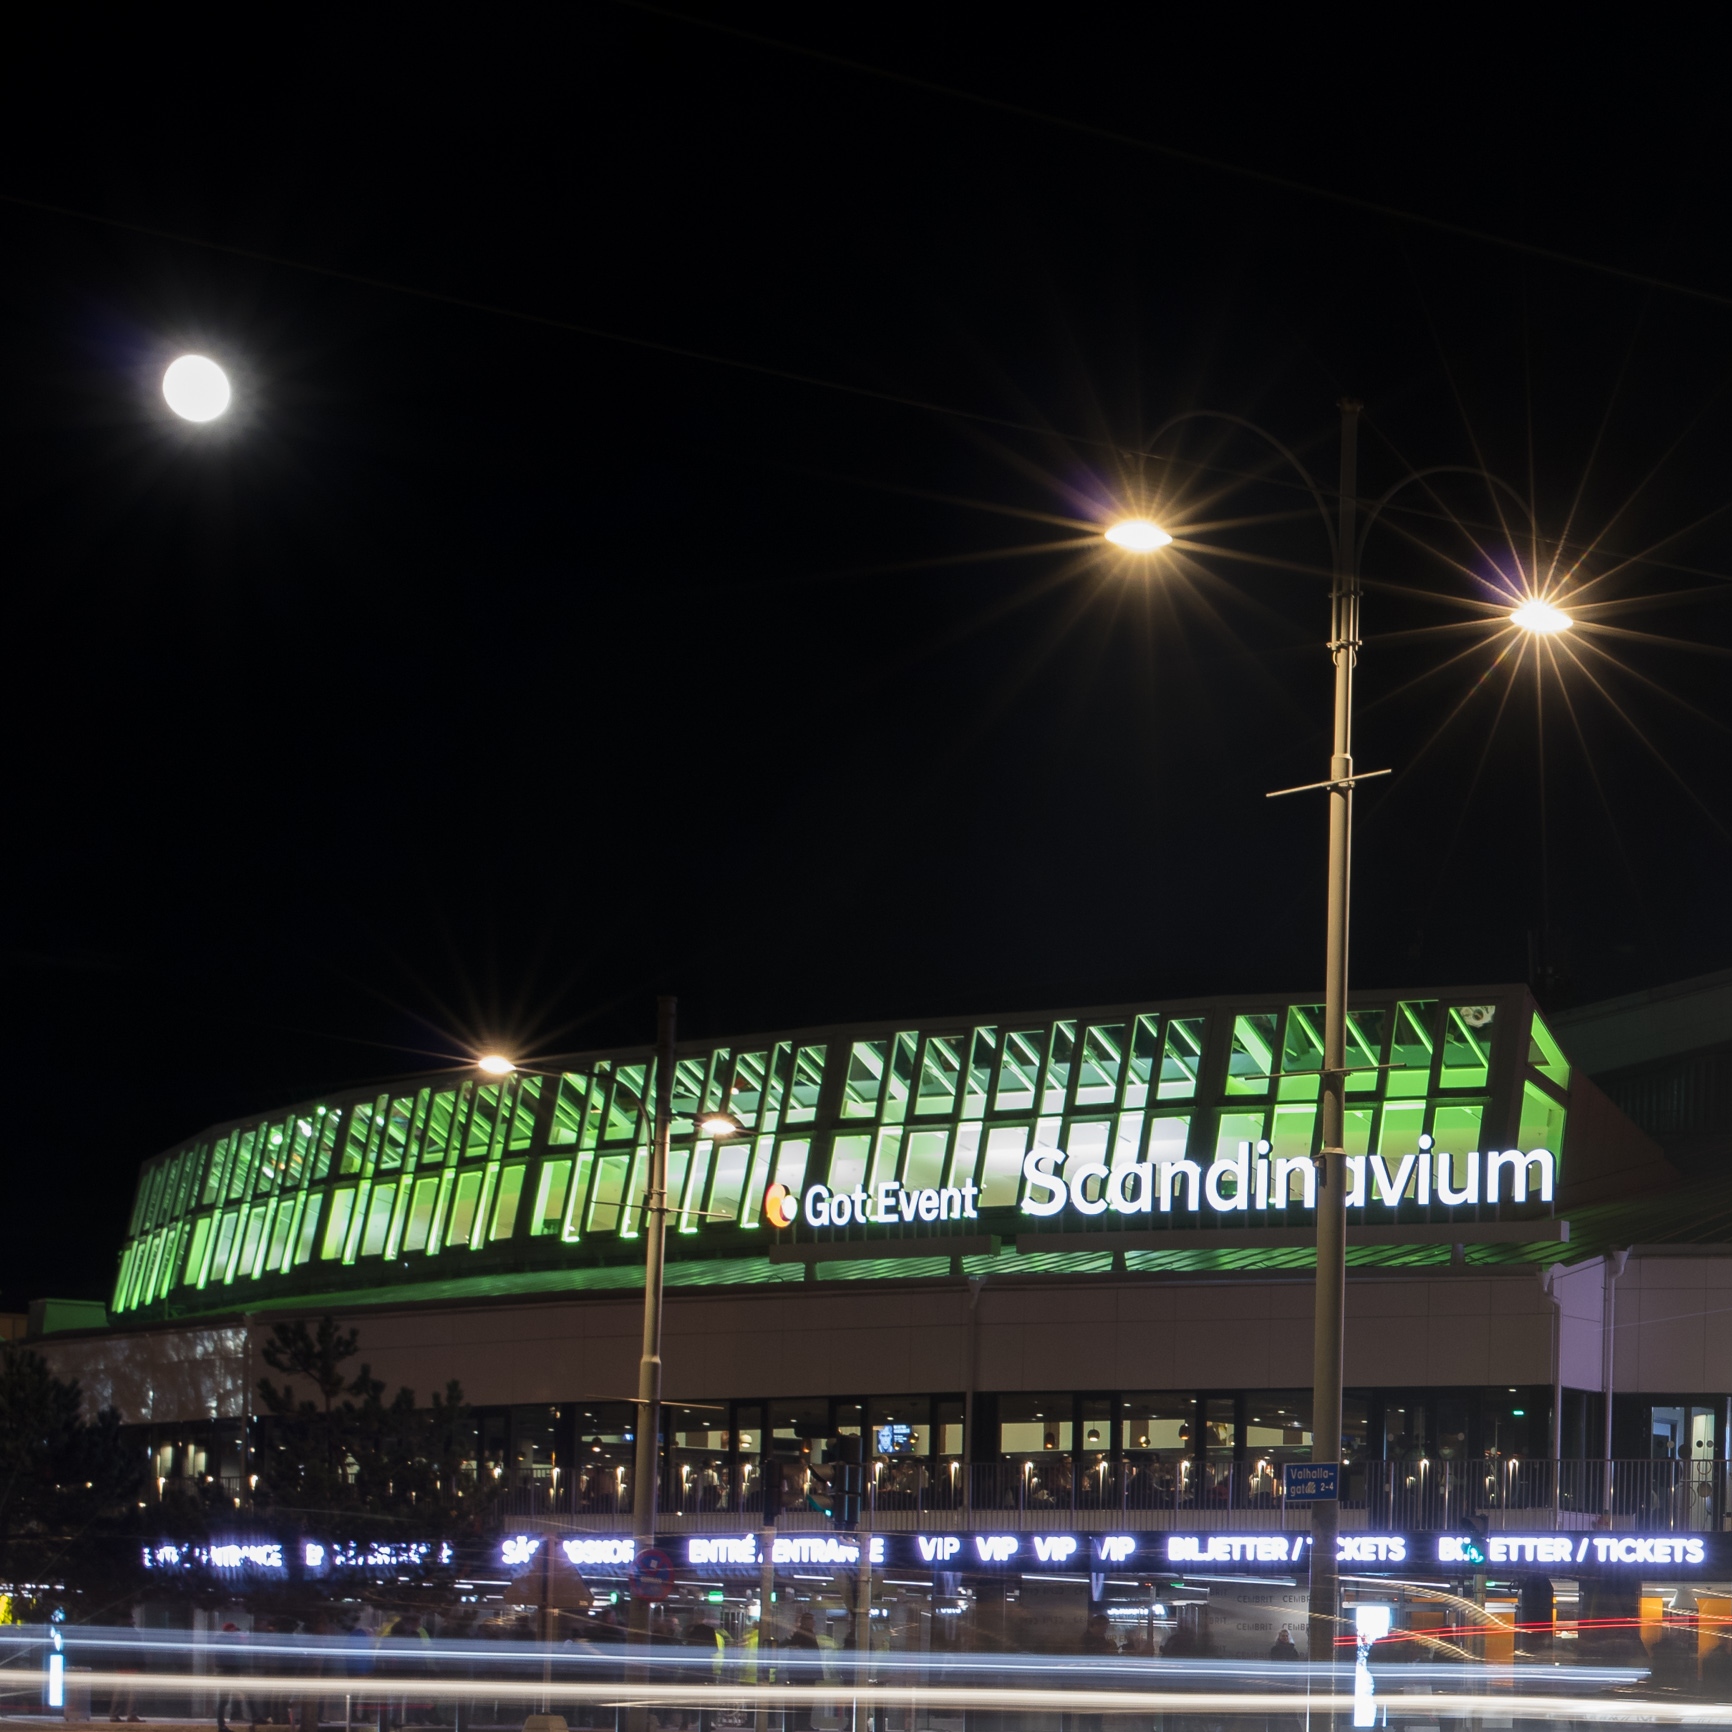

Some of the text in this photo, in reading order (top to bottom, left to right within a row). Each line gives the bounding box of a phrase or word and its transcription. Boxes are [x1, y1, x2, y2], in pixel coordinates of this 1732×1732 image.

[804, 1177, 979, 1228] Got Event
[1290, 1468, 1334, 1480] Valhalla-
[1320, 1482, 1334, 1492] 2-4
[688, 1533, 757, 1564] ENTRÉ
[918, 1536, 960, 1561] VIP
[976, 1536, 1018, 1562] VIP
[1034, 1536, 1076, 1562] VIP
[1167, 1536, 1288, 1561] BILJETTER
[1593, 1537, 1705, 1563] TICKETS
[1237, 1595, 1273, 1603] CEMBRIT
[1236, 1623, 1273, 1631] CEMBRIT
